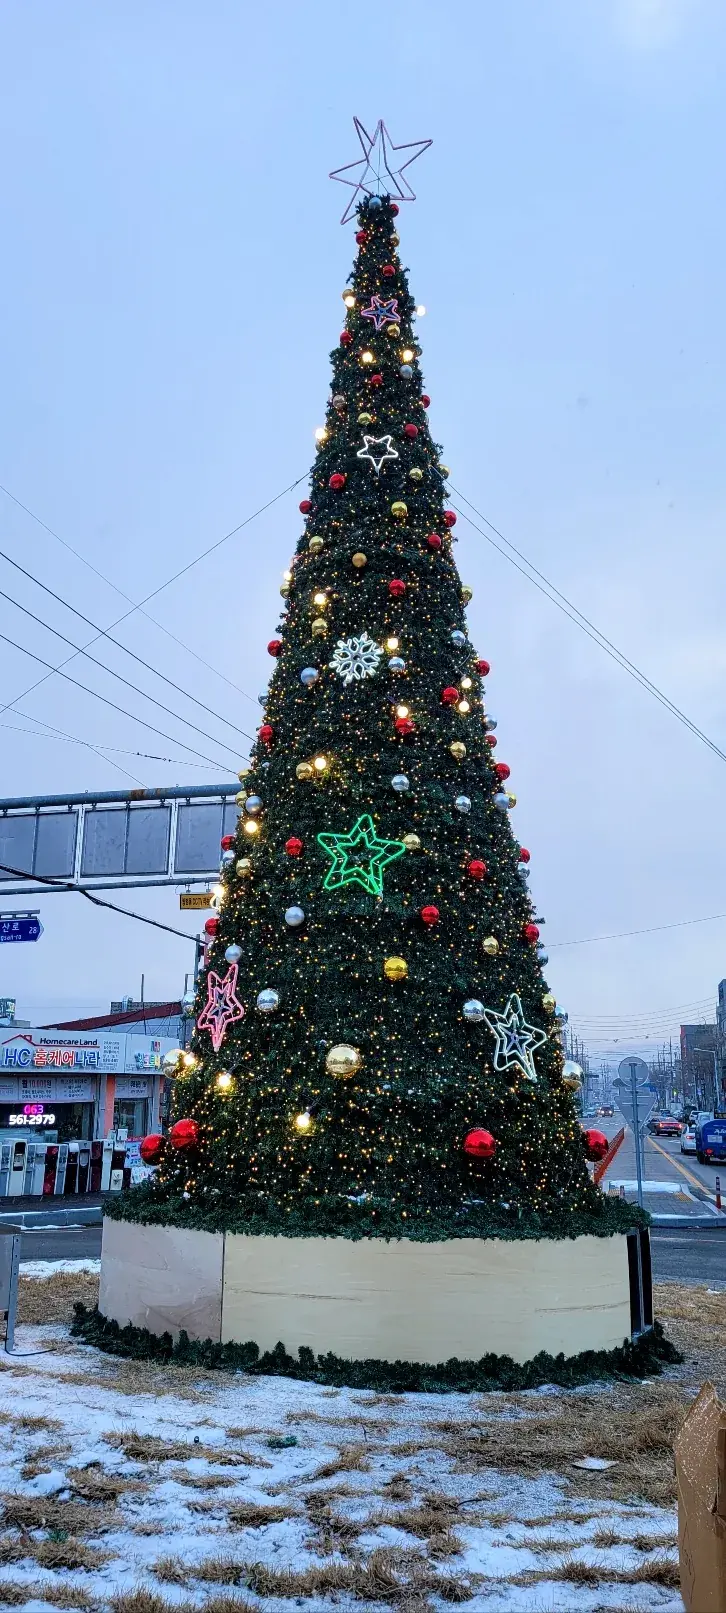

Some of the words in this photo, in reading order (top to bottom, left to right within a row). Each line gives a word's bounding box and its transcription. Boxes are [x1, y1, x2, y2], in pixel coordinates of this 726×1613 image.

[28, 926, 38, 934] 28
[39, 1037, 79, 1045] Homecare
[4, 1047, 31, 1066] HC
[33, 1049, 101, 1067] 홈케어나라
[23, 1104, 44, 1114] 063
[8, 1114, 56, 1125] 561-2979
